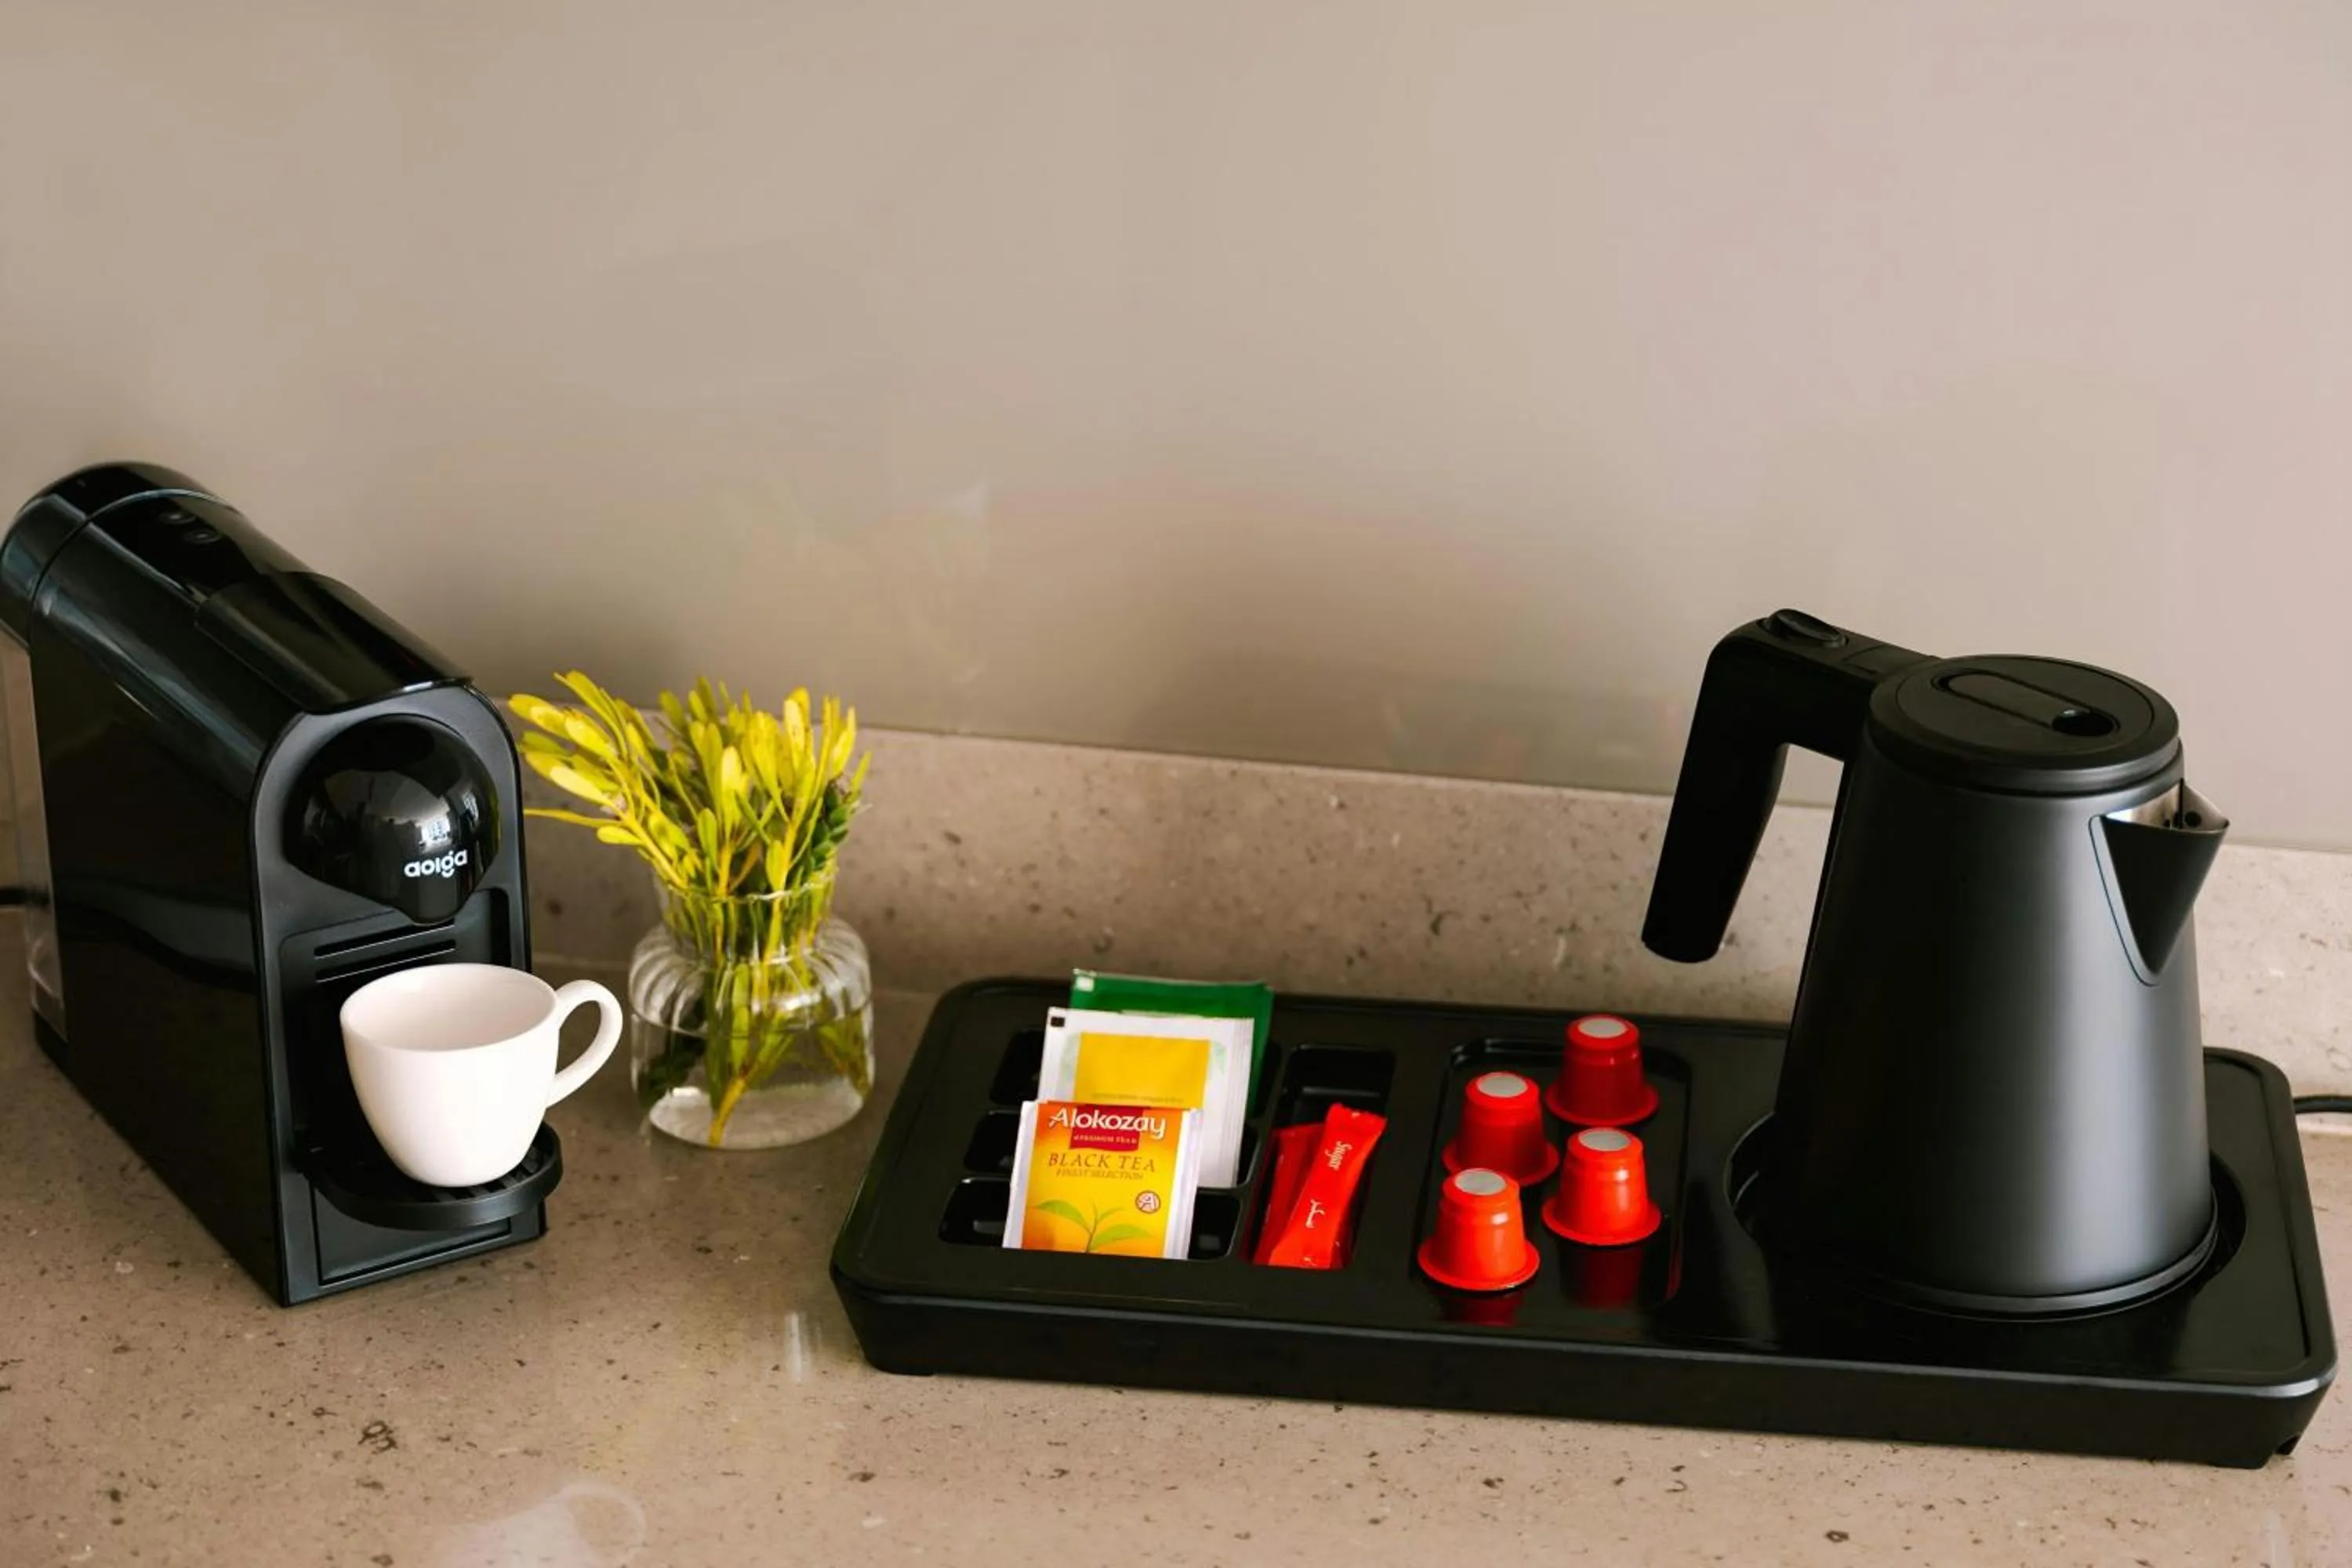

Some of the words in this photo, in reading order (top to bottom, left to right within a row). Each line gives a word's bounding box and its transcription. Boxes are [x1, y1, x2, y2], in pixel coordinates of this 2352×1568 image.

[1048, 1107, 1166, 1140] Alokozay
[1048, 1152, 1111, 1169] BLACK
[1118, 1156, 1156, 1173] TEA
